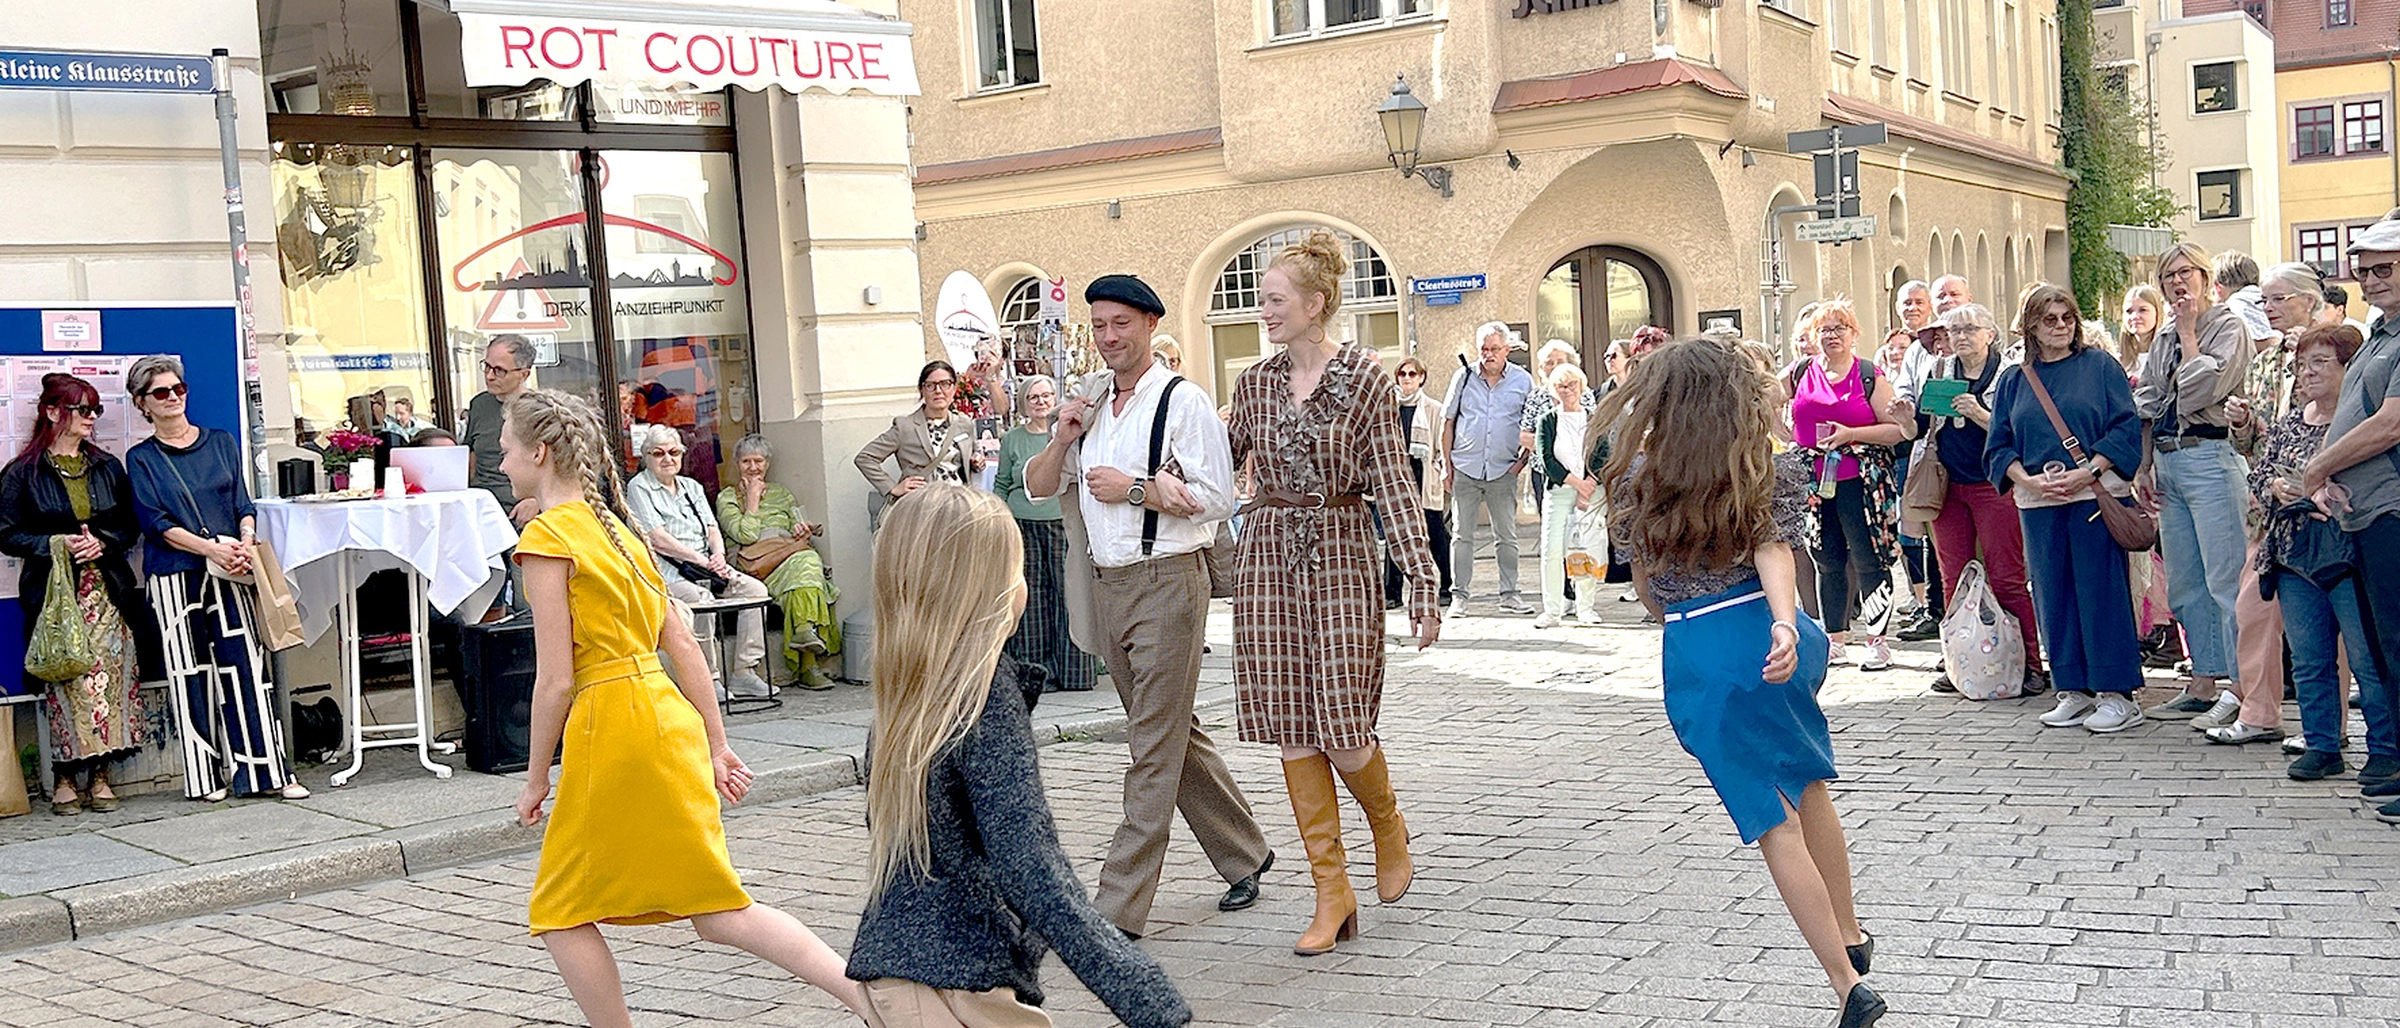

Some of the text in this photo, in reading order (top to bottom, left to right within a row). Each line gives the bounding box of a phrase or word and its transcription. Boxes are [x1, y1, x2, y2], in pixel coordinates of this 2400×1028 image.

[500, 25, 890, 81] ROT COUTURE
[68, 60, 200, 88] Klausstraße
[545, 298, 725, 317] DRK ANZIEHPUNKT
[1864, 579, 1891, 624] NIKE
